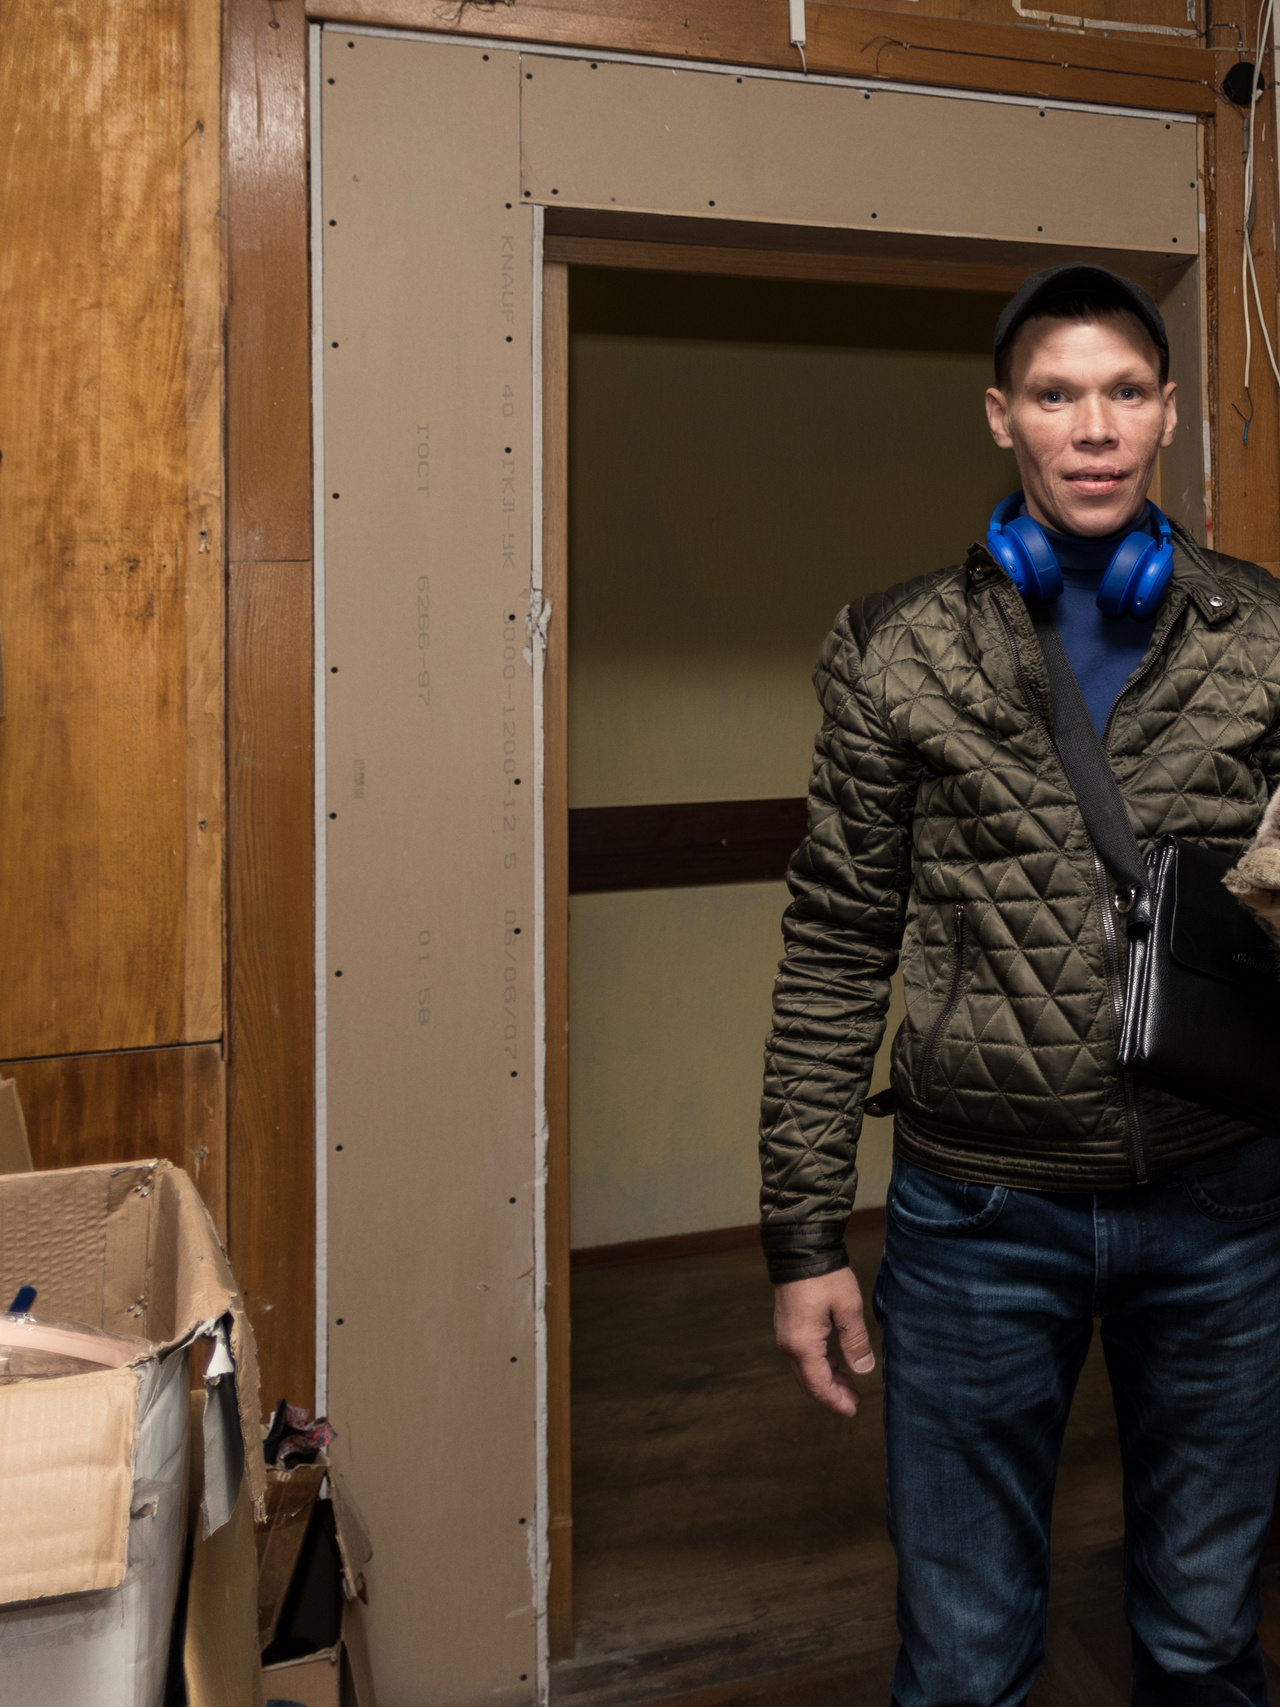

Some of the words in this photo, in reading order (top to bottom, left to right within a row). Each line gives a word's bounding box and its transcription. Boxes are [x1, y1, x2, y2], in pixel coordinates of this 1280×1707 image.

[501, 234, 516, 326] KNAUF
[501, 383, 515, 419] 40
[416, 423, 431, 499] ГОСТ
[416, 574, 432, 707] 6266-97
[502, 908, 520, 1061] 06/06/07
